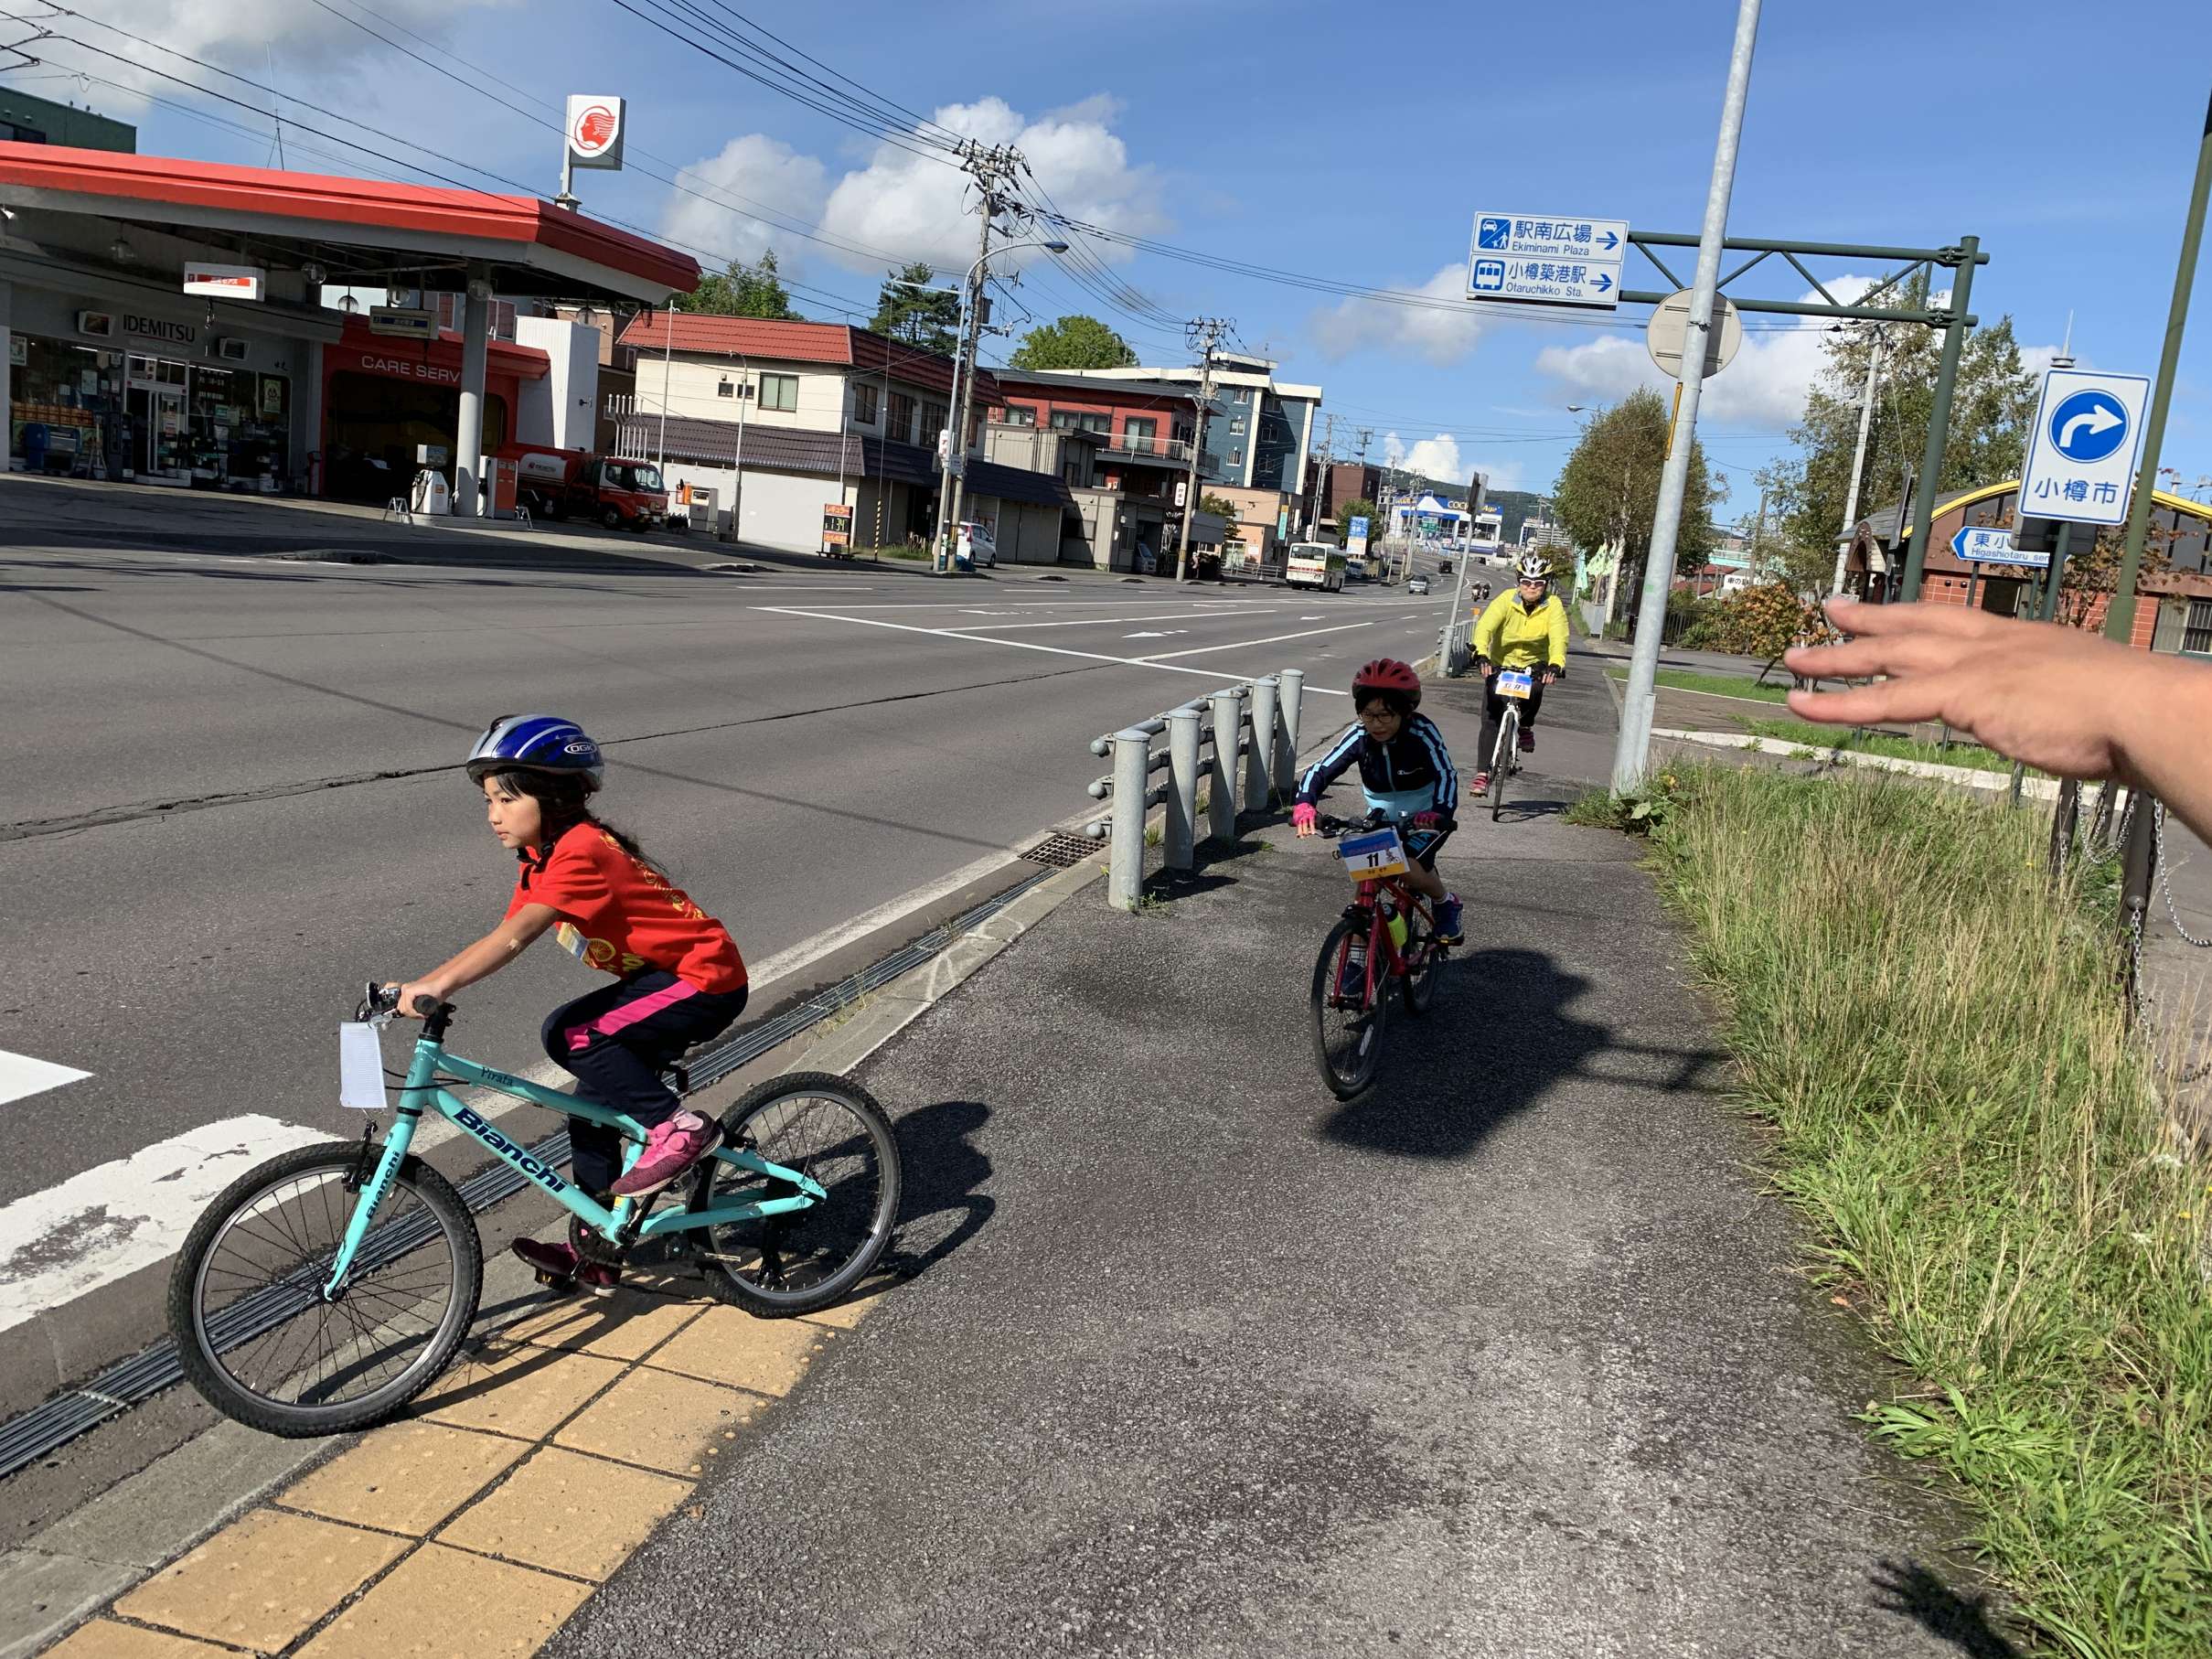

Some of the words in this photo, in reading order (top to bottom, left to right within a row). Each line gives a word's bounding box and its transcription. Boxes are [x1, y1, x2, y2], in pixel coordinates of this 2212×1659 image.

[1514, 220, 1593, 243] 駅南広場
[1512, 241, 1559, 254] Ekiminami
[1563, 244, 1589, 256] Plaza
[1508, 262, 1587, 284] 小樽築港駅
[1506, 282, 1560, 295] Otaruchikko
[1565, 286, 1584, 297] Sta.
[123, 314, 196, 343] IDEMITSU
[361, 355, 411, 376] CARE
[416, 365, 461, 382] SERV
[2034, 476, 2119, 504] 小樽市
[1974, 532, 2012, 549] 東小
[1972, 548, 2028, 561] Higashiotaru
[571, 744, 593, 753] OGK
[1366, 852, 1379, 868] 11
[481, 1066, 514, 1087] Pirata
[454, 1108, 569, 1193] Bianchi
[366, 1151, 401, 1220] Bianchi
